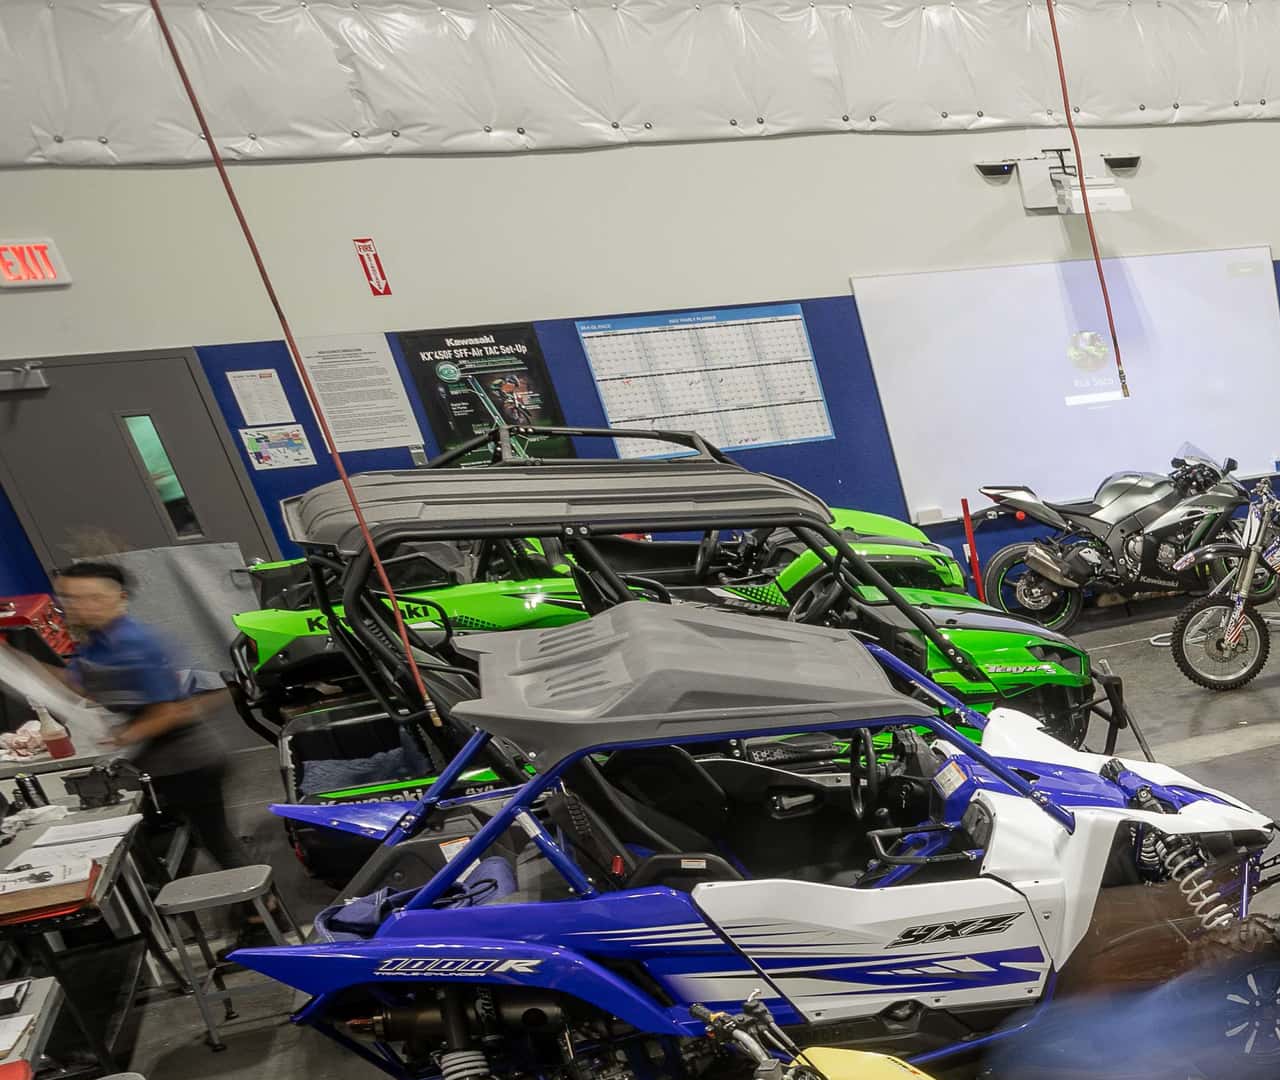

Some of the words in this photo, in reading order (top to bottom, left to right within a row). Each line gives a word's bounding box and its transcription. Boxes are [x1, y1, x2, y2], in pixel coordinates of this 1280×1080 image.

[0, 245, 57, 280] EXIT
[445, 335, 495, 347] Kawasaki
[484, 345, 499, 355] TAC
[500, 343, 528, 354] Set-Up
[1140, 575, 1179, 587] Kawasaki
[886, 911, 1026, 949] YXZ
